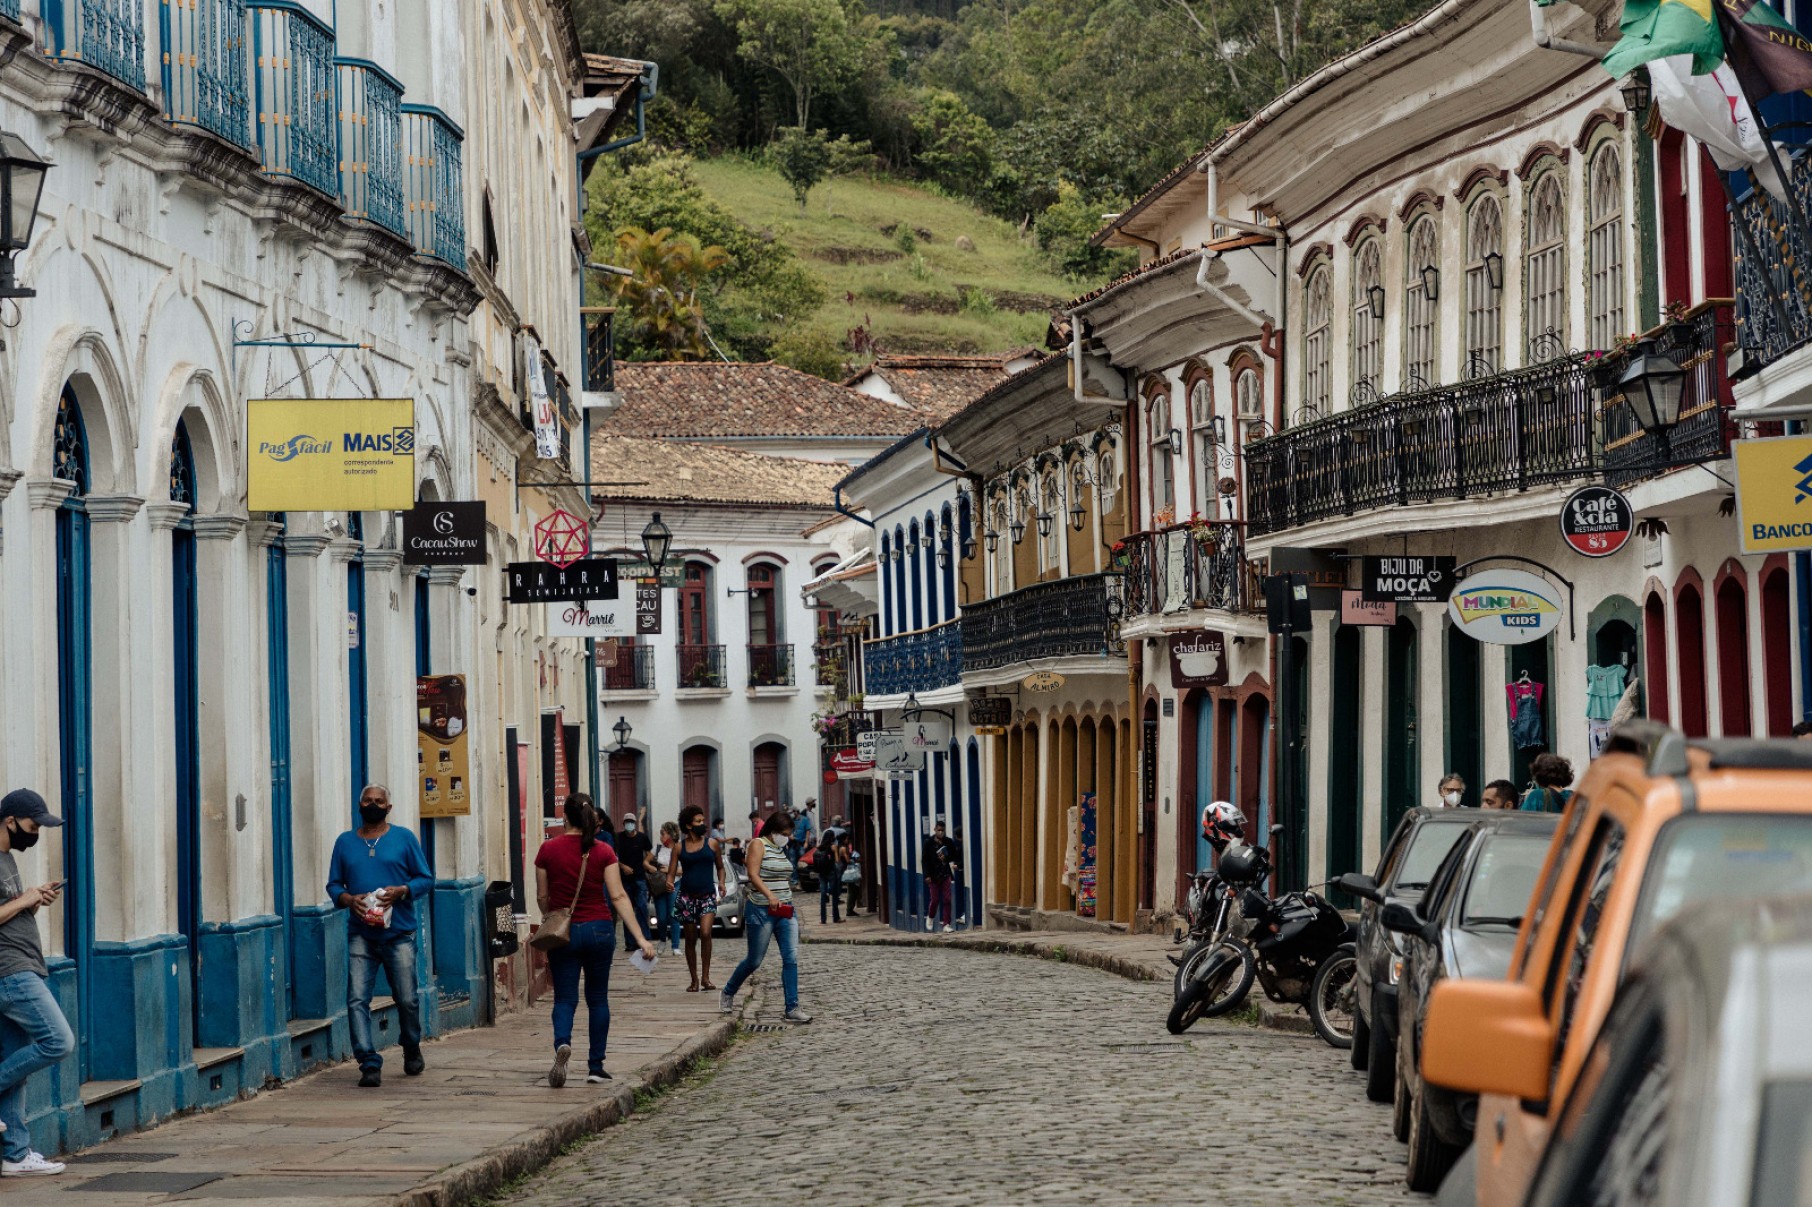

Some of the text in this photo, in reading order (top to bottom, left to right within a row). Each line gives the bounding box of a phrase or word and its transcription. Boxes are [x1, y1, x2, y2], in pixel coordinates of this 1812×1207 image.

[1769, 30, 1812, 52] NIG
[258, 441, 286, 456] Pag
[343, 432, 393, 452] MAIS
[1572, 493, 1617, 513] Café
[1574, 523, 1620, 533] RESTAURANTE
[1752, 522, 1812, 540] BANCO
[1380, 558, 1425, 575] BIJU DA
[515, 569, 611, 588] RAHRA
[1376, 577, 1431, 596] MOÇA
[1463, 594, 1539, 610] MUNDIAL
[1506, 616, 1537, 625] KIDS
[1172, 635, 1222, 654] chafariz
